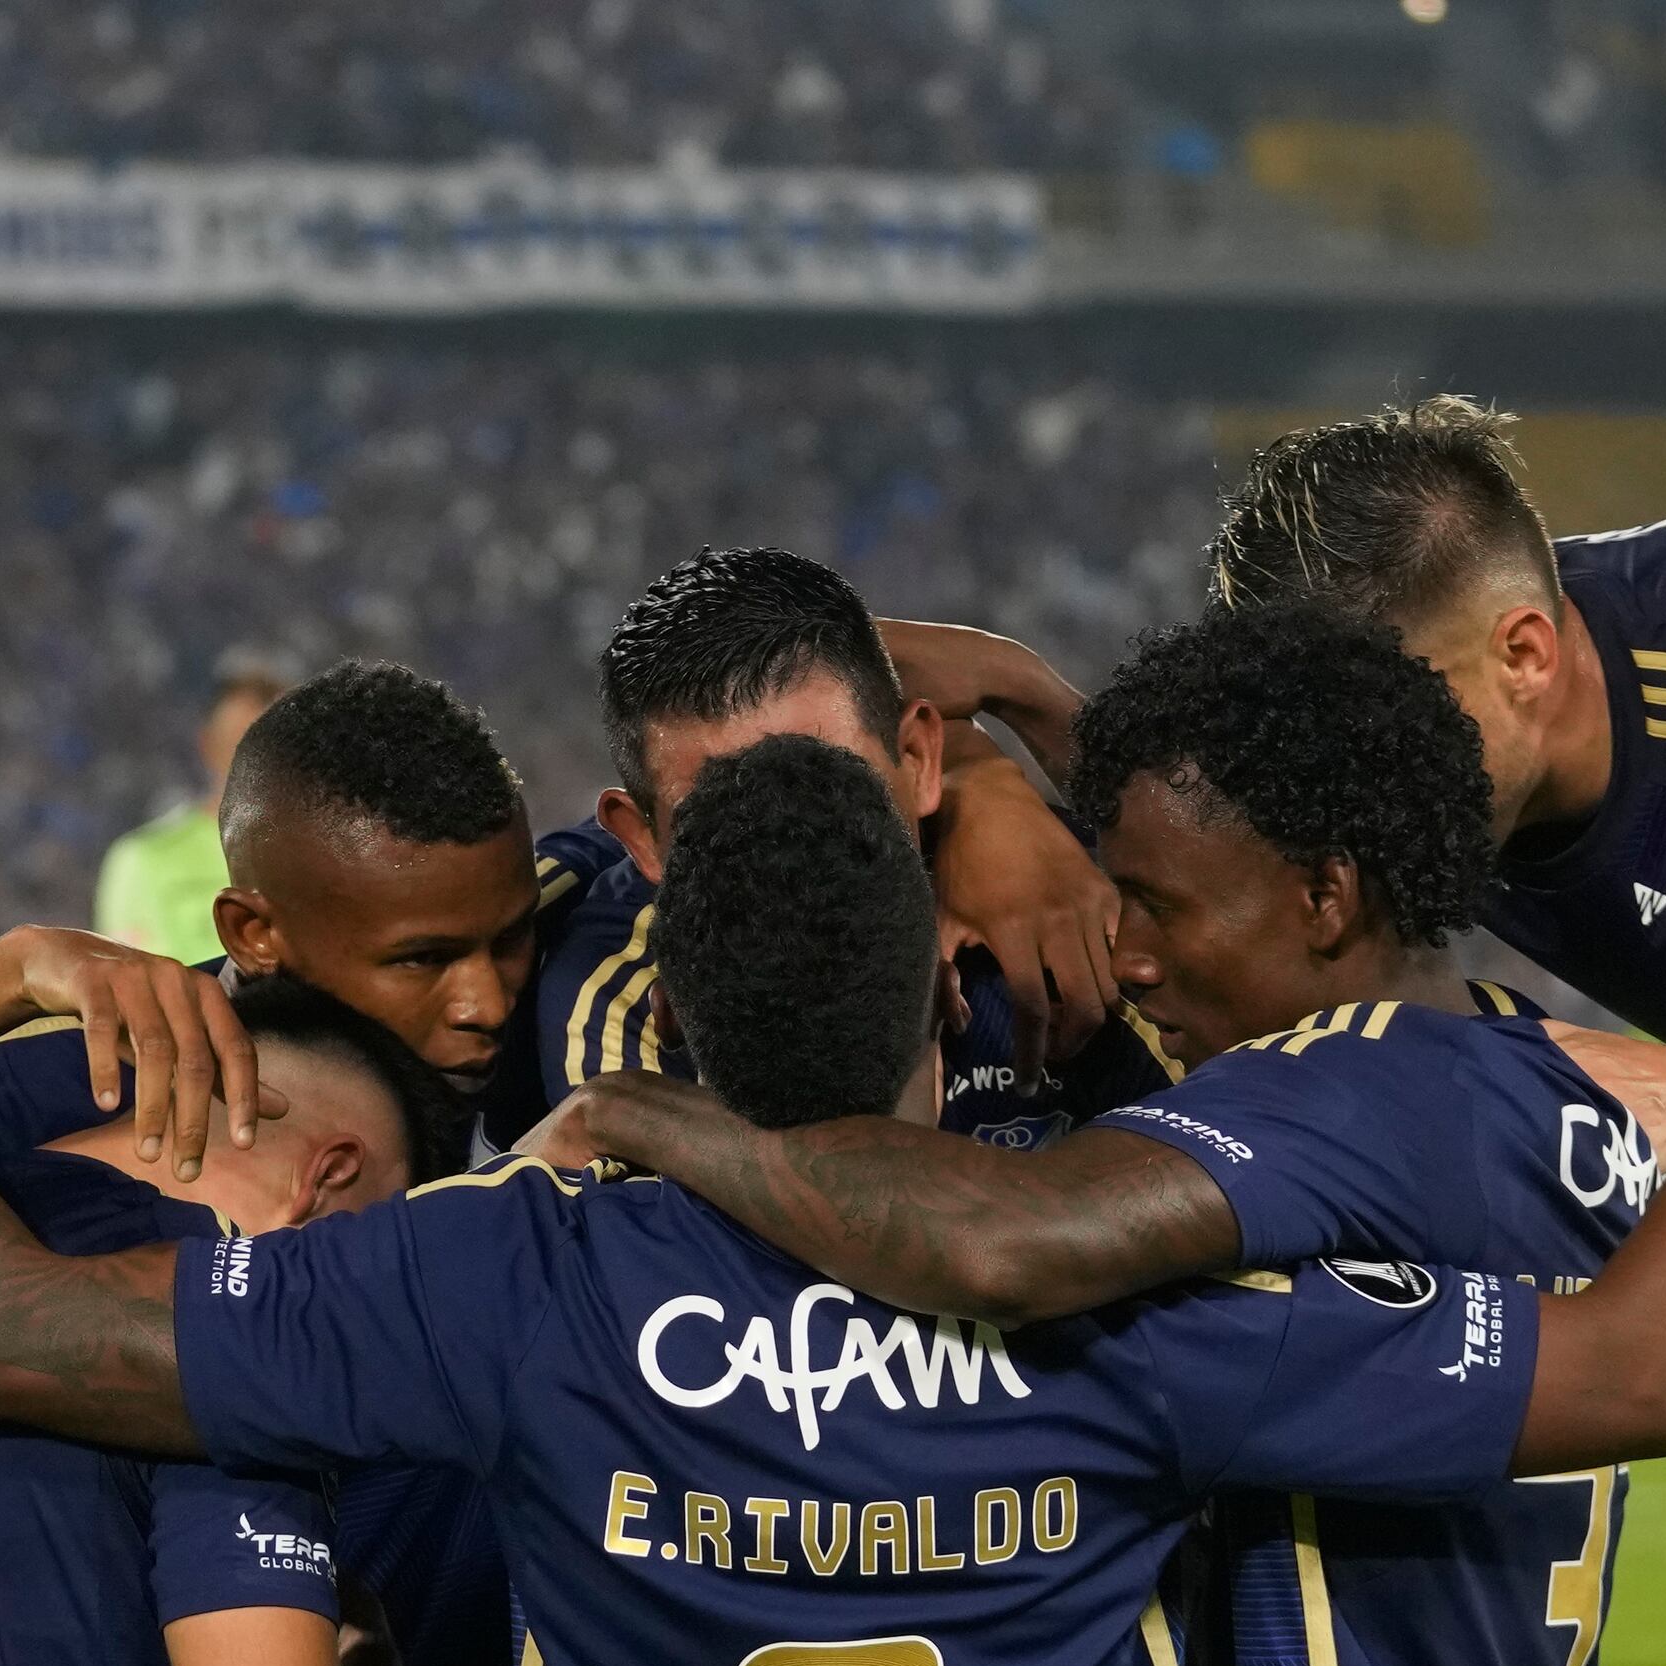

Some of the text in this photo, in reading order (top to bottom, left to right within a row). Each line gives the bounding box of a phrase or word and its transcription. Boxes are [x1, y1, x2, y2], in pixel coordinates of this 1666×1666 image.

[1488, 1298, 1503, 1368] GLOBAL
[603, 1470, 1079, 1577] E.RIVALDO
[259, 1556, 323, 1576] GLOBAL
